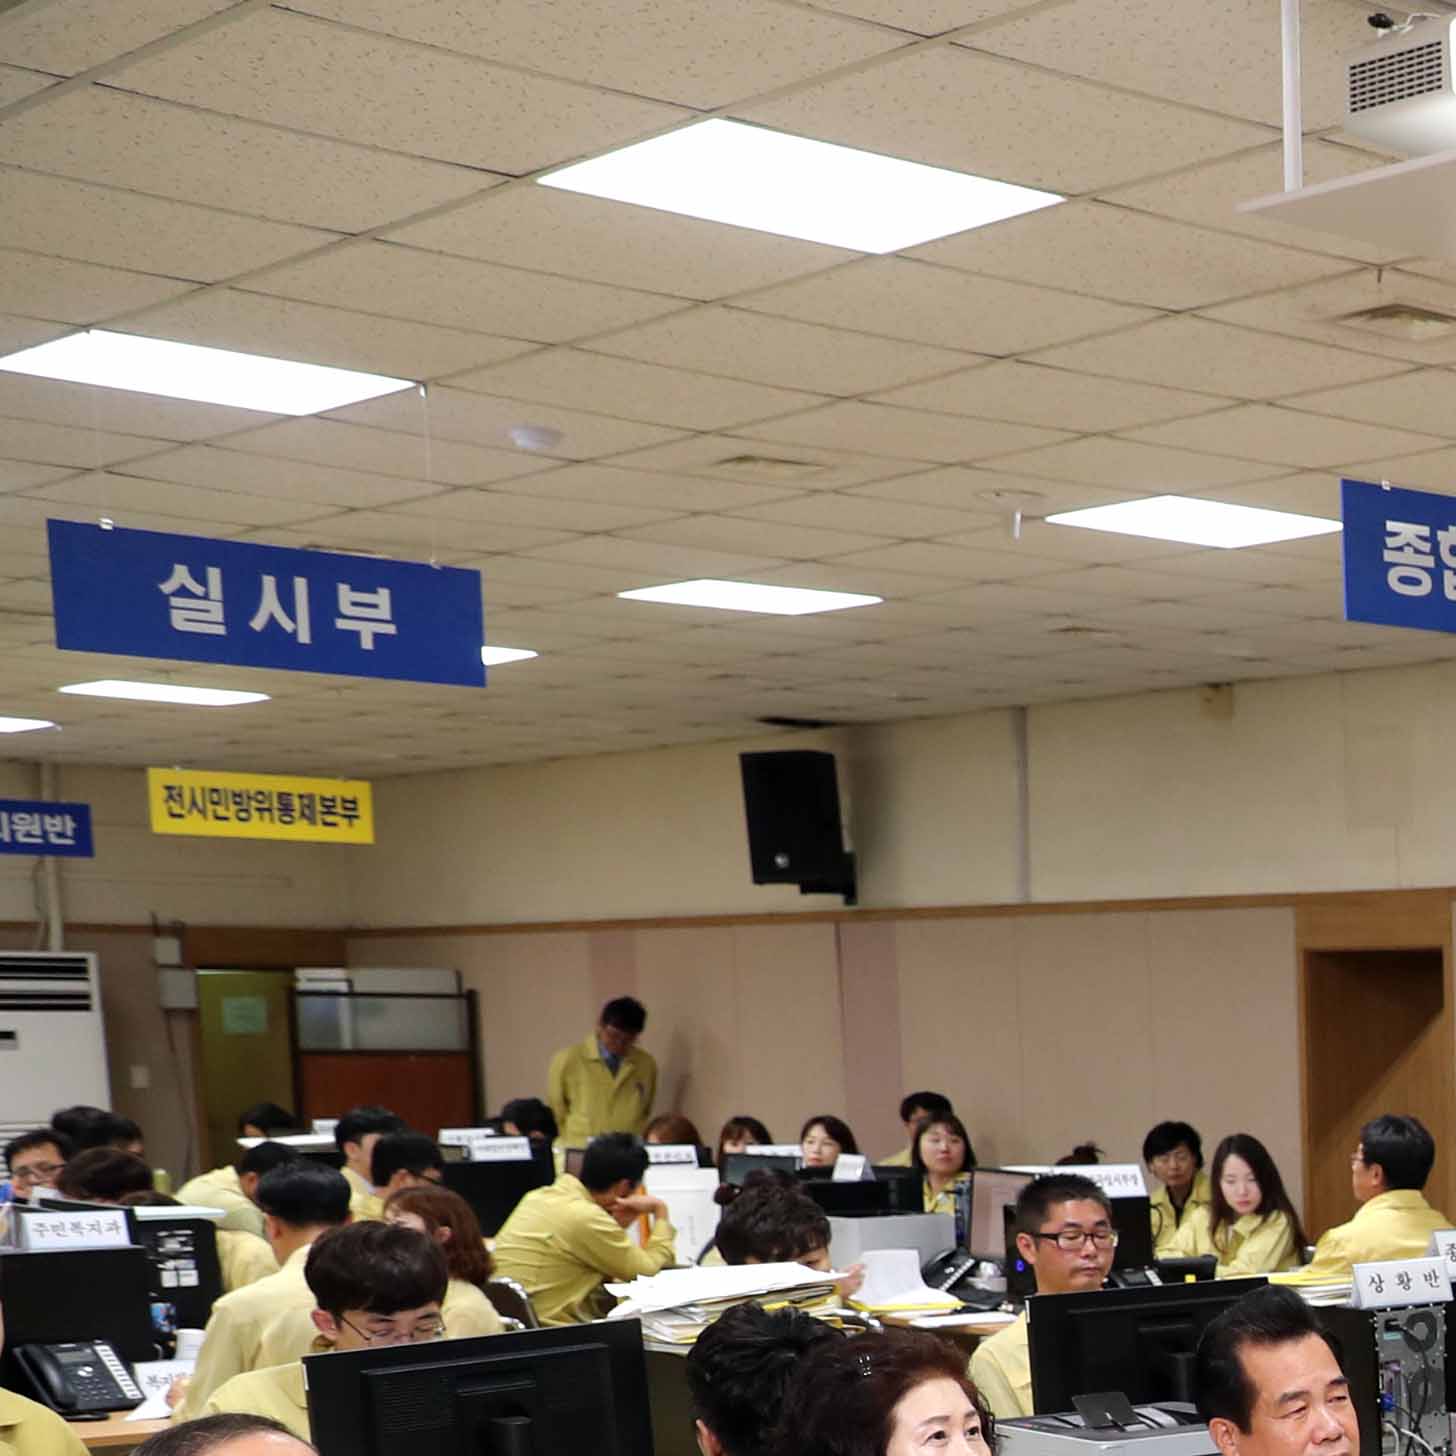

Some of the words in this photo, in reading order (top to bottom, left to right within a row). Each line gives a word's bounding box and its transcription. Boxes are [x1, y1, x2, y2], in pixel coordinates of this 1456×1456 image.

[158, 563, 398, 651] 실시부
[162, 784, 361, 829] 전시민방위통제본부
[1368, 1269, 1441, 1294] 상황반
